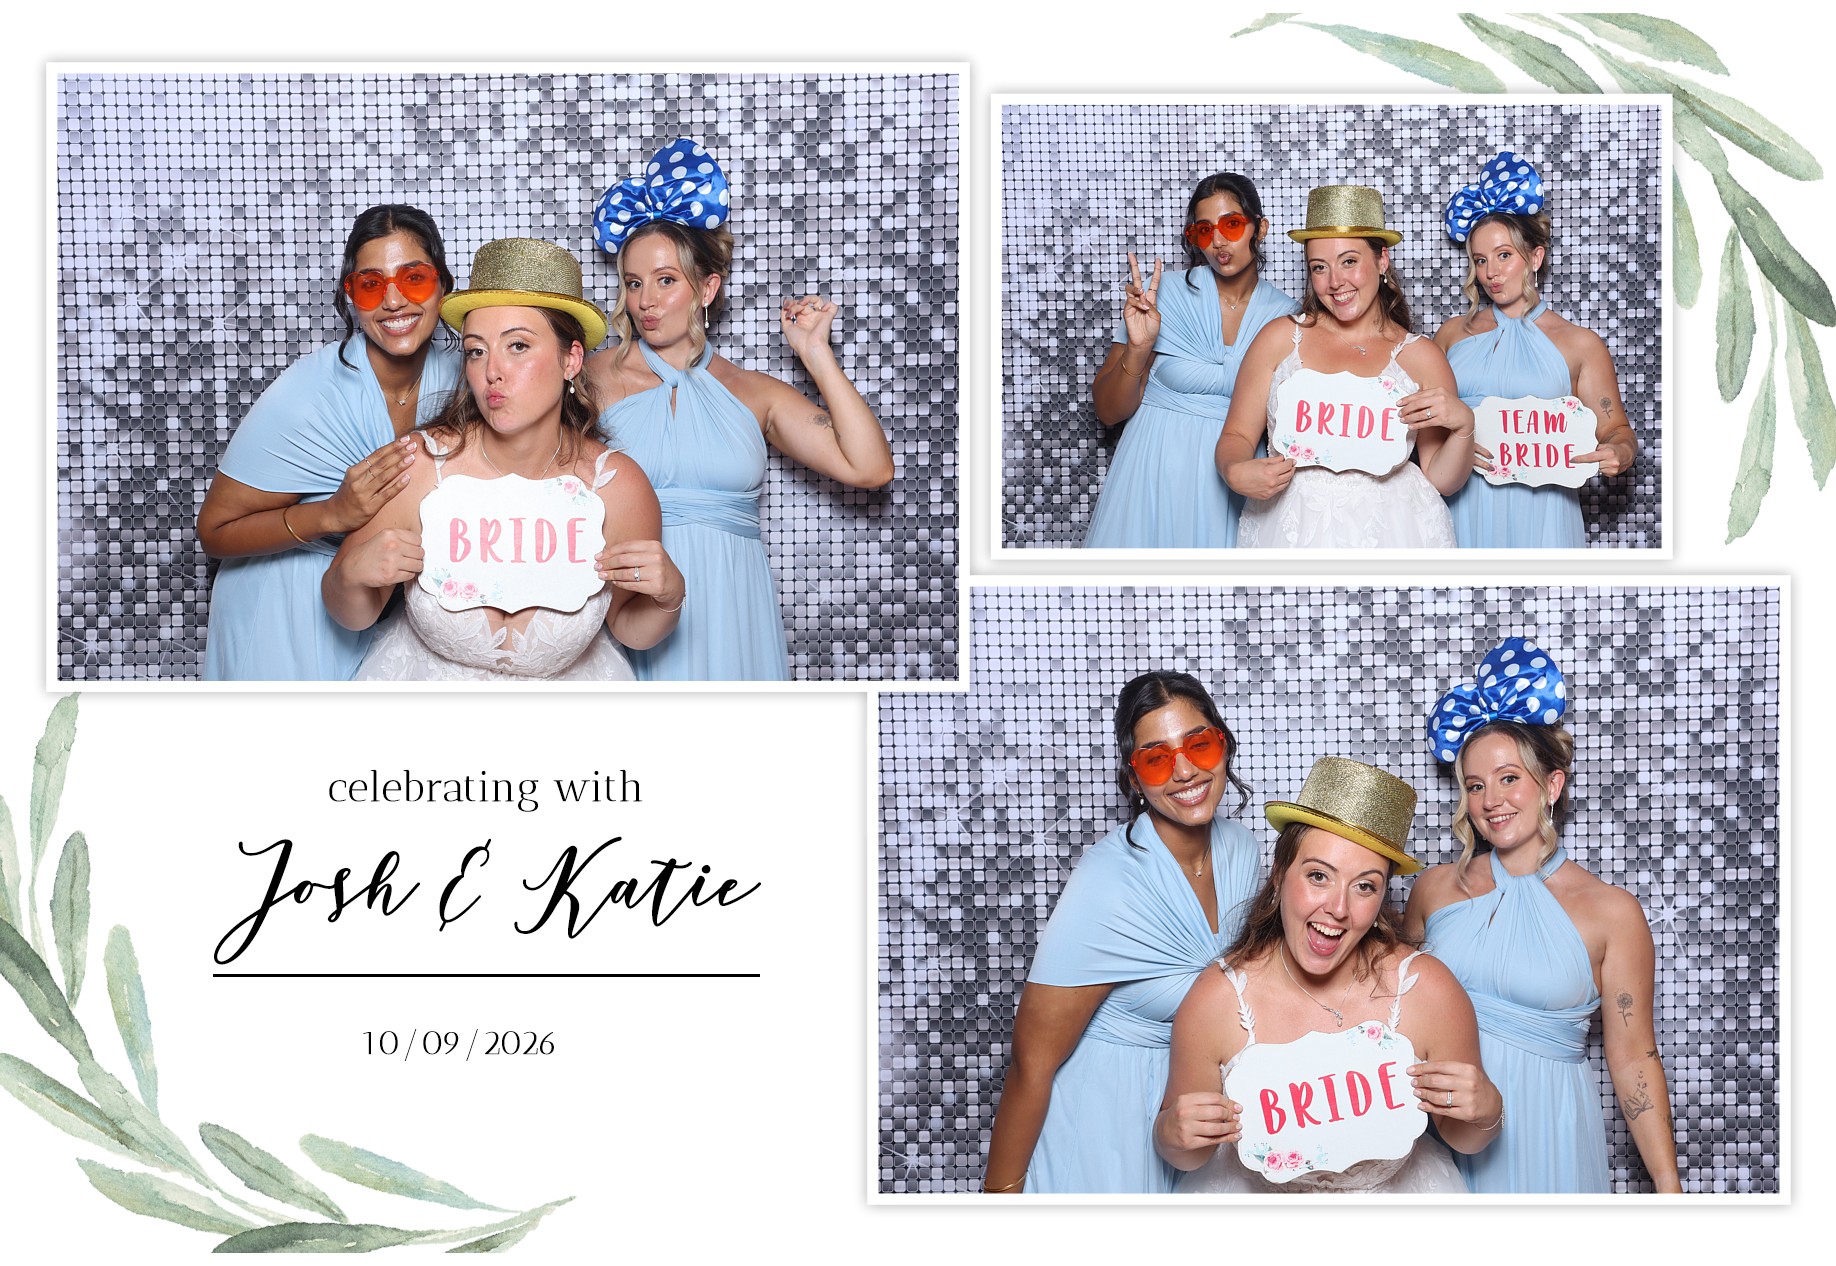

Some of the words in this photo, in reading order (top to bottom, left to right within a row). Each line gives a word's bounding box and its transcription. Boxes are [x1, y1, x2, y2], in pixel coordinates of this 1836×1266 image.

[1295, 399, 1398, 442] BRIDE
[1498, 409, 1568, 435] TEAM
[1499, 442, 1577, 469] BRIDE
[449, 517, 587, 564] BRIDE
[1259, 1061, 1406, 1135] BRIDE
